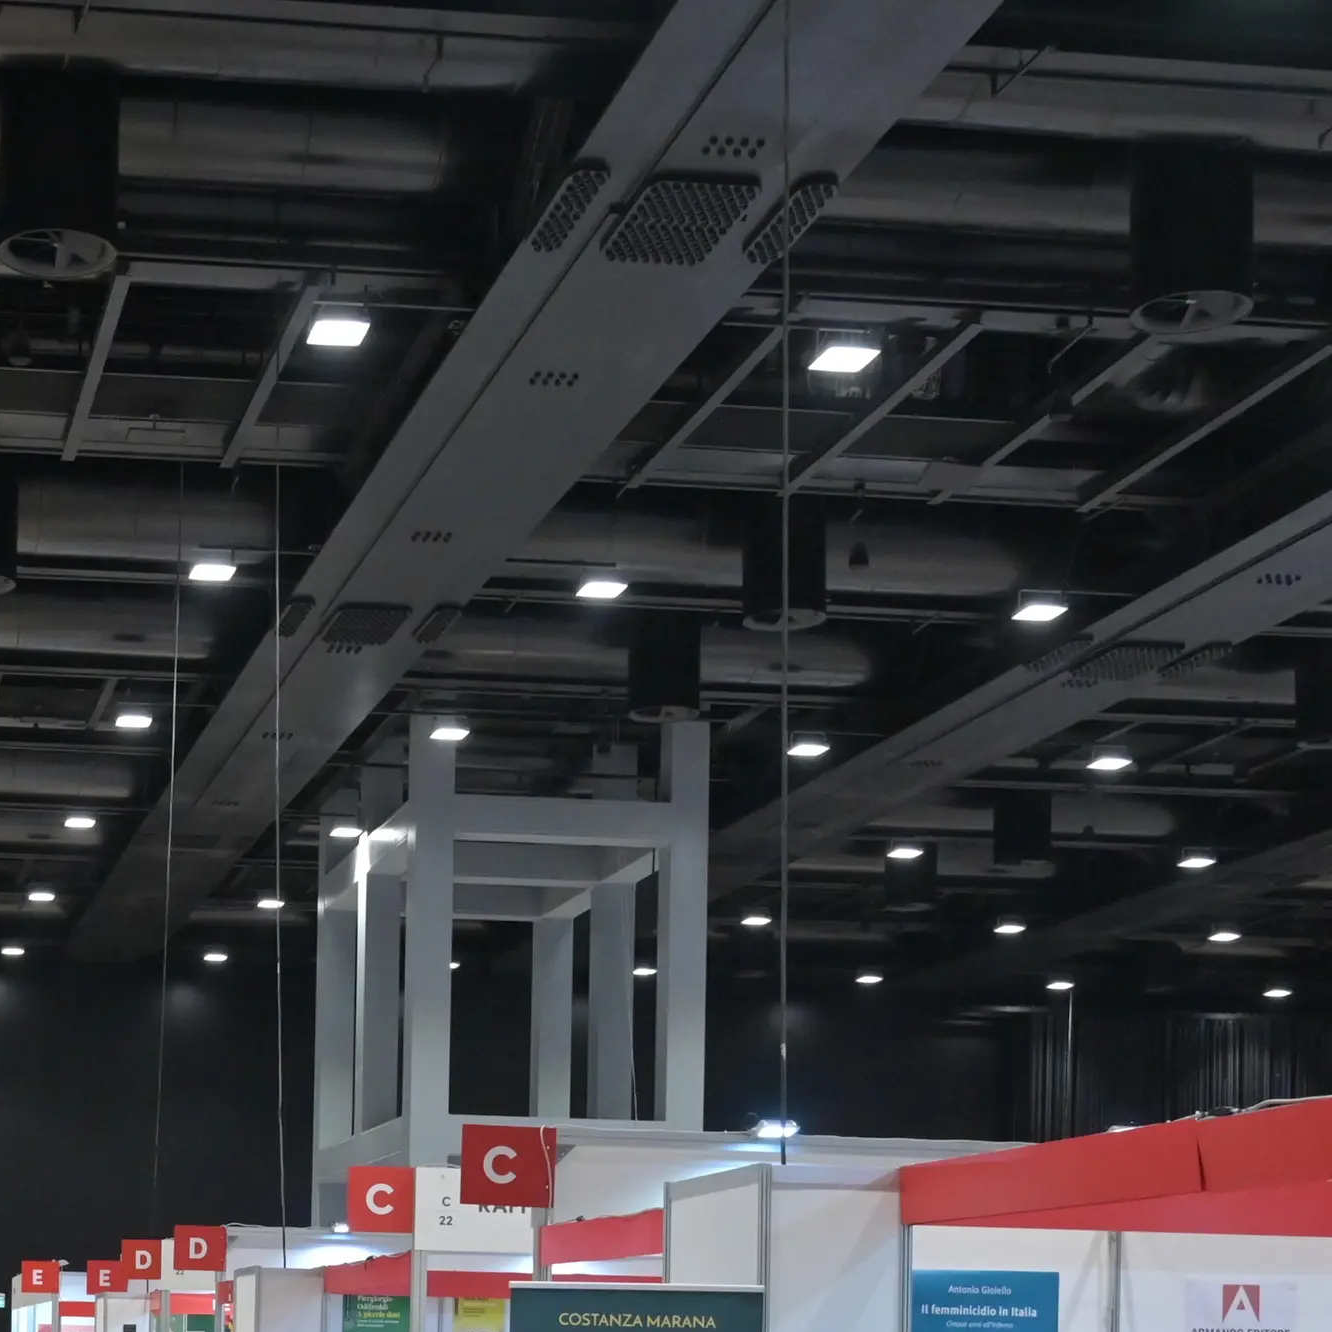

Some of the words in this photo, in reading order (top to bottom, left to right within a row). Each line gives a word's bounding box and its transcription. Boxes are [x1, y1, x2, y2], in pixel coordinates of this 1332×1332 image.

[483, 1145, 517, 1184] C
[365, 1183, 395, 1215] C
[441, 1196, 452, 1207] C
[439, 1215, 454, 1226] 22
[189, 1237, 208, 1260] D
[135, 1250, 152, 1270] D
[32, 1269, 43, 1286] E
[99, 1269, 111, 1287] E
[948, 1285, 980, 1294] Antonio
[981, 1286, 1012, 1296] Gioiello
[921, 1304, 928, 1315] Il
[931, 1304, 997, 1317] femminicidio
[999, 1305, 1009, 1317] in
[1011, 1307, 1038, 1318] Italia
[558, 1312, 643, 1328] COSTANZA
[646, 1315, 717, 1329] MARANA
